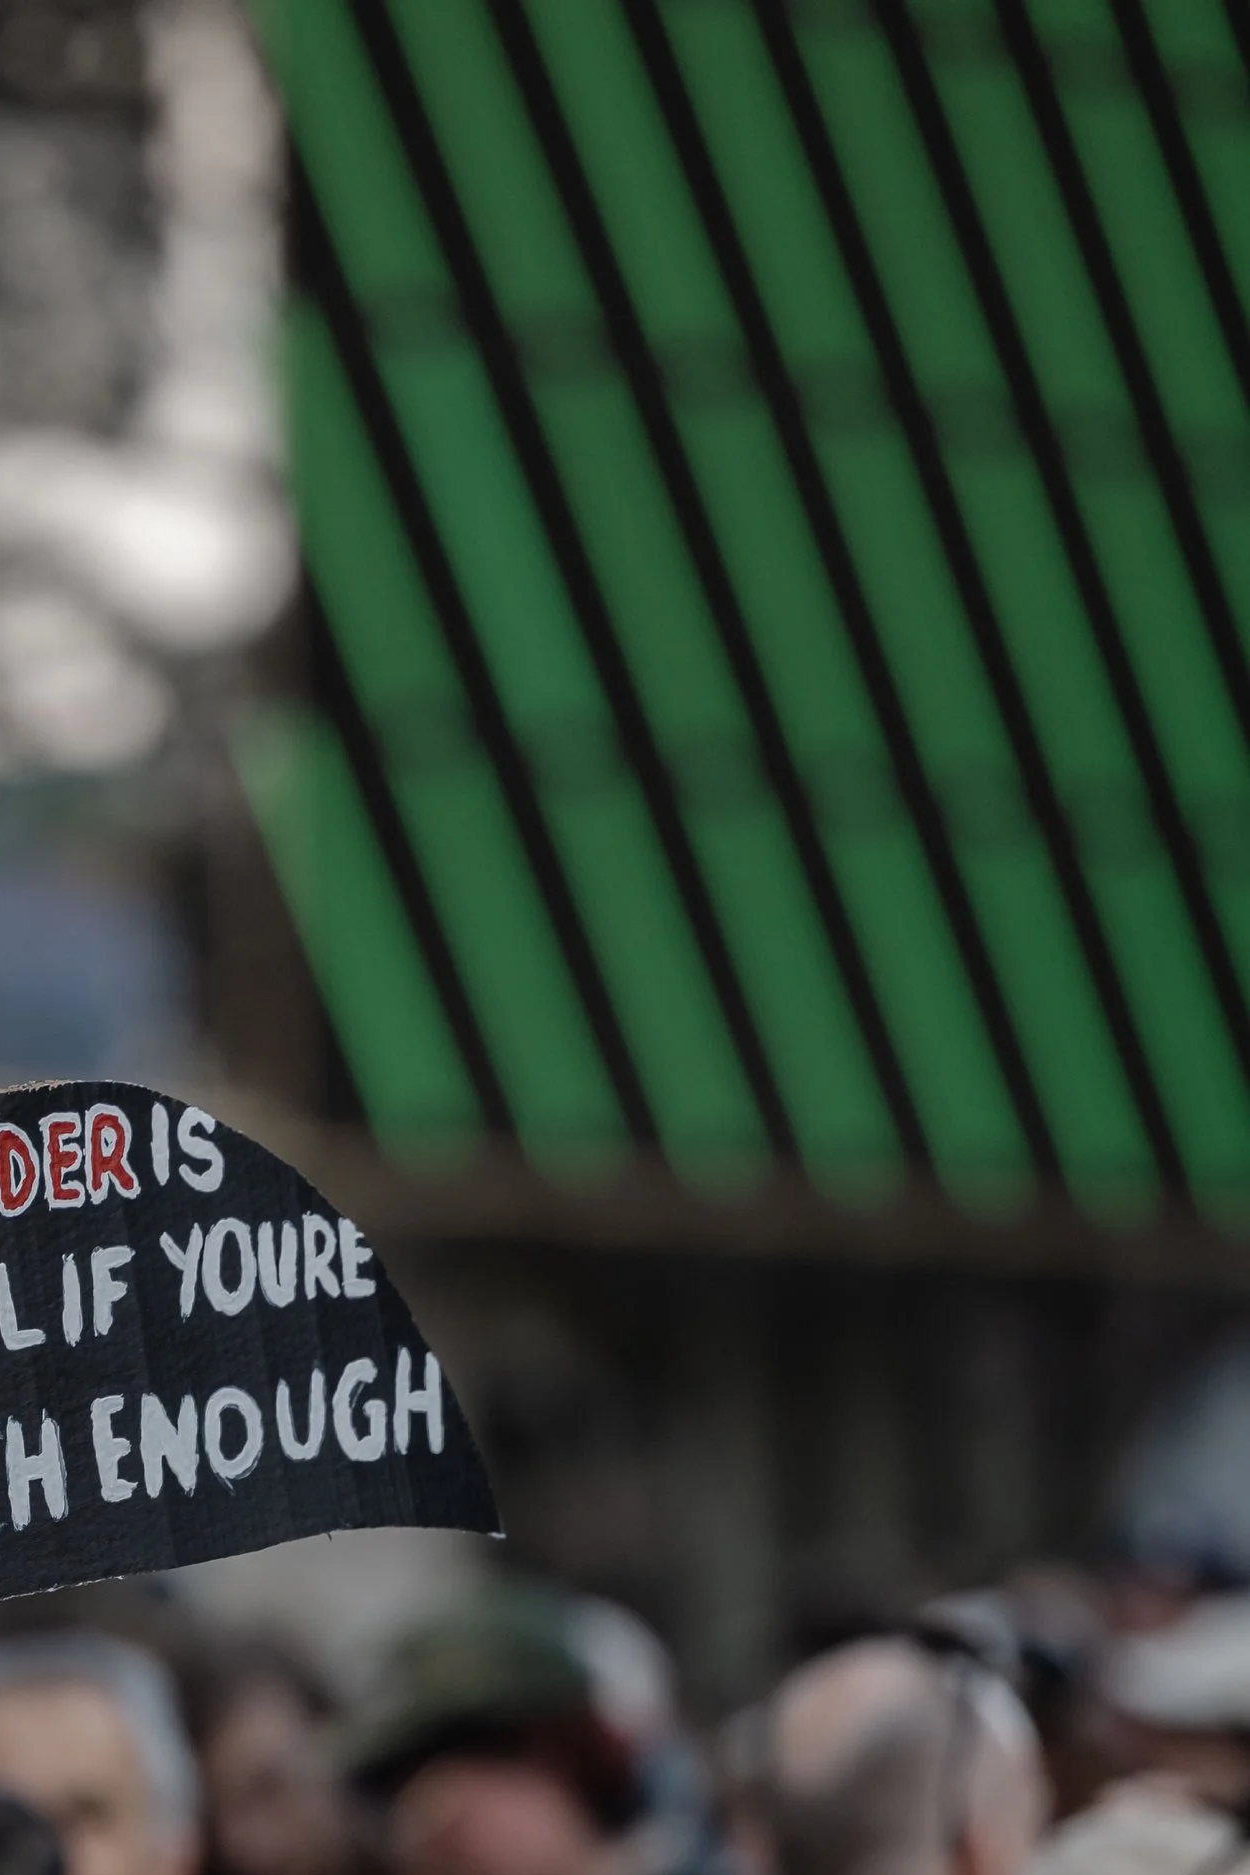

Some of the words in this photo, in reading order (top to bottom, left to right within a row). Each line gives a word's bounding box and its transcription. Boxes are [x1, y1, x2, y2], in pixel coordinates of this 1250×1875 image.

[151, 1102, 224, 1192] IS
[63, 1245, 136, 1347] IF
[160, 1211, 377, 1323] YOURE
[91, 1346, 444, 1503] ENOUGH
